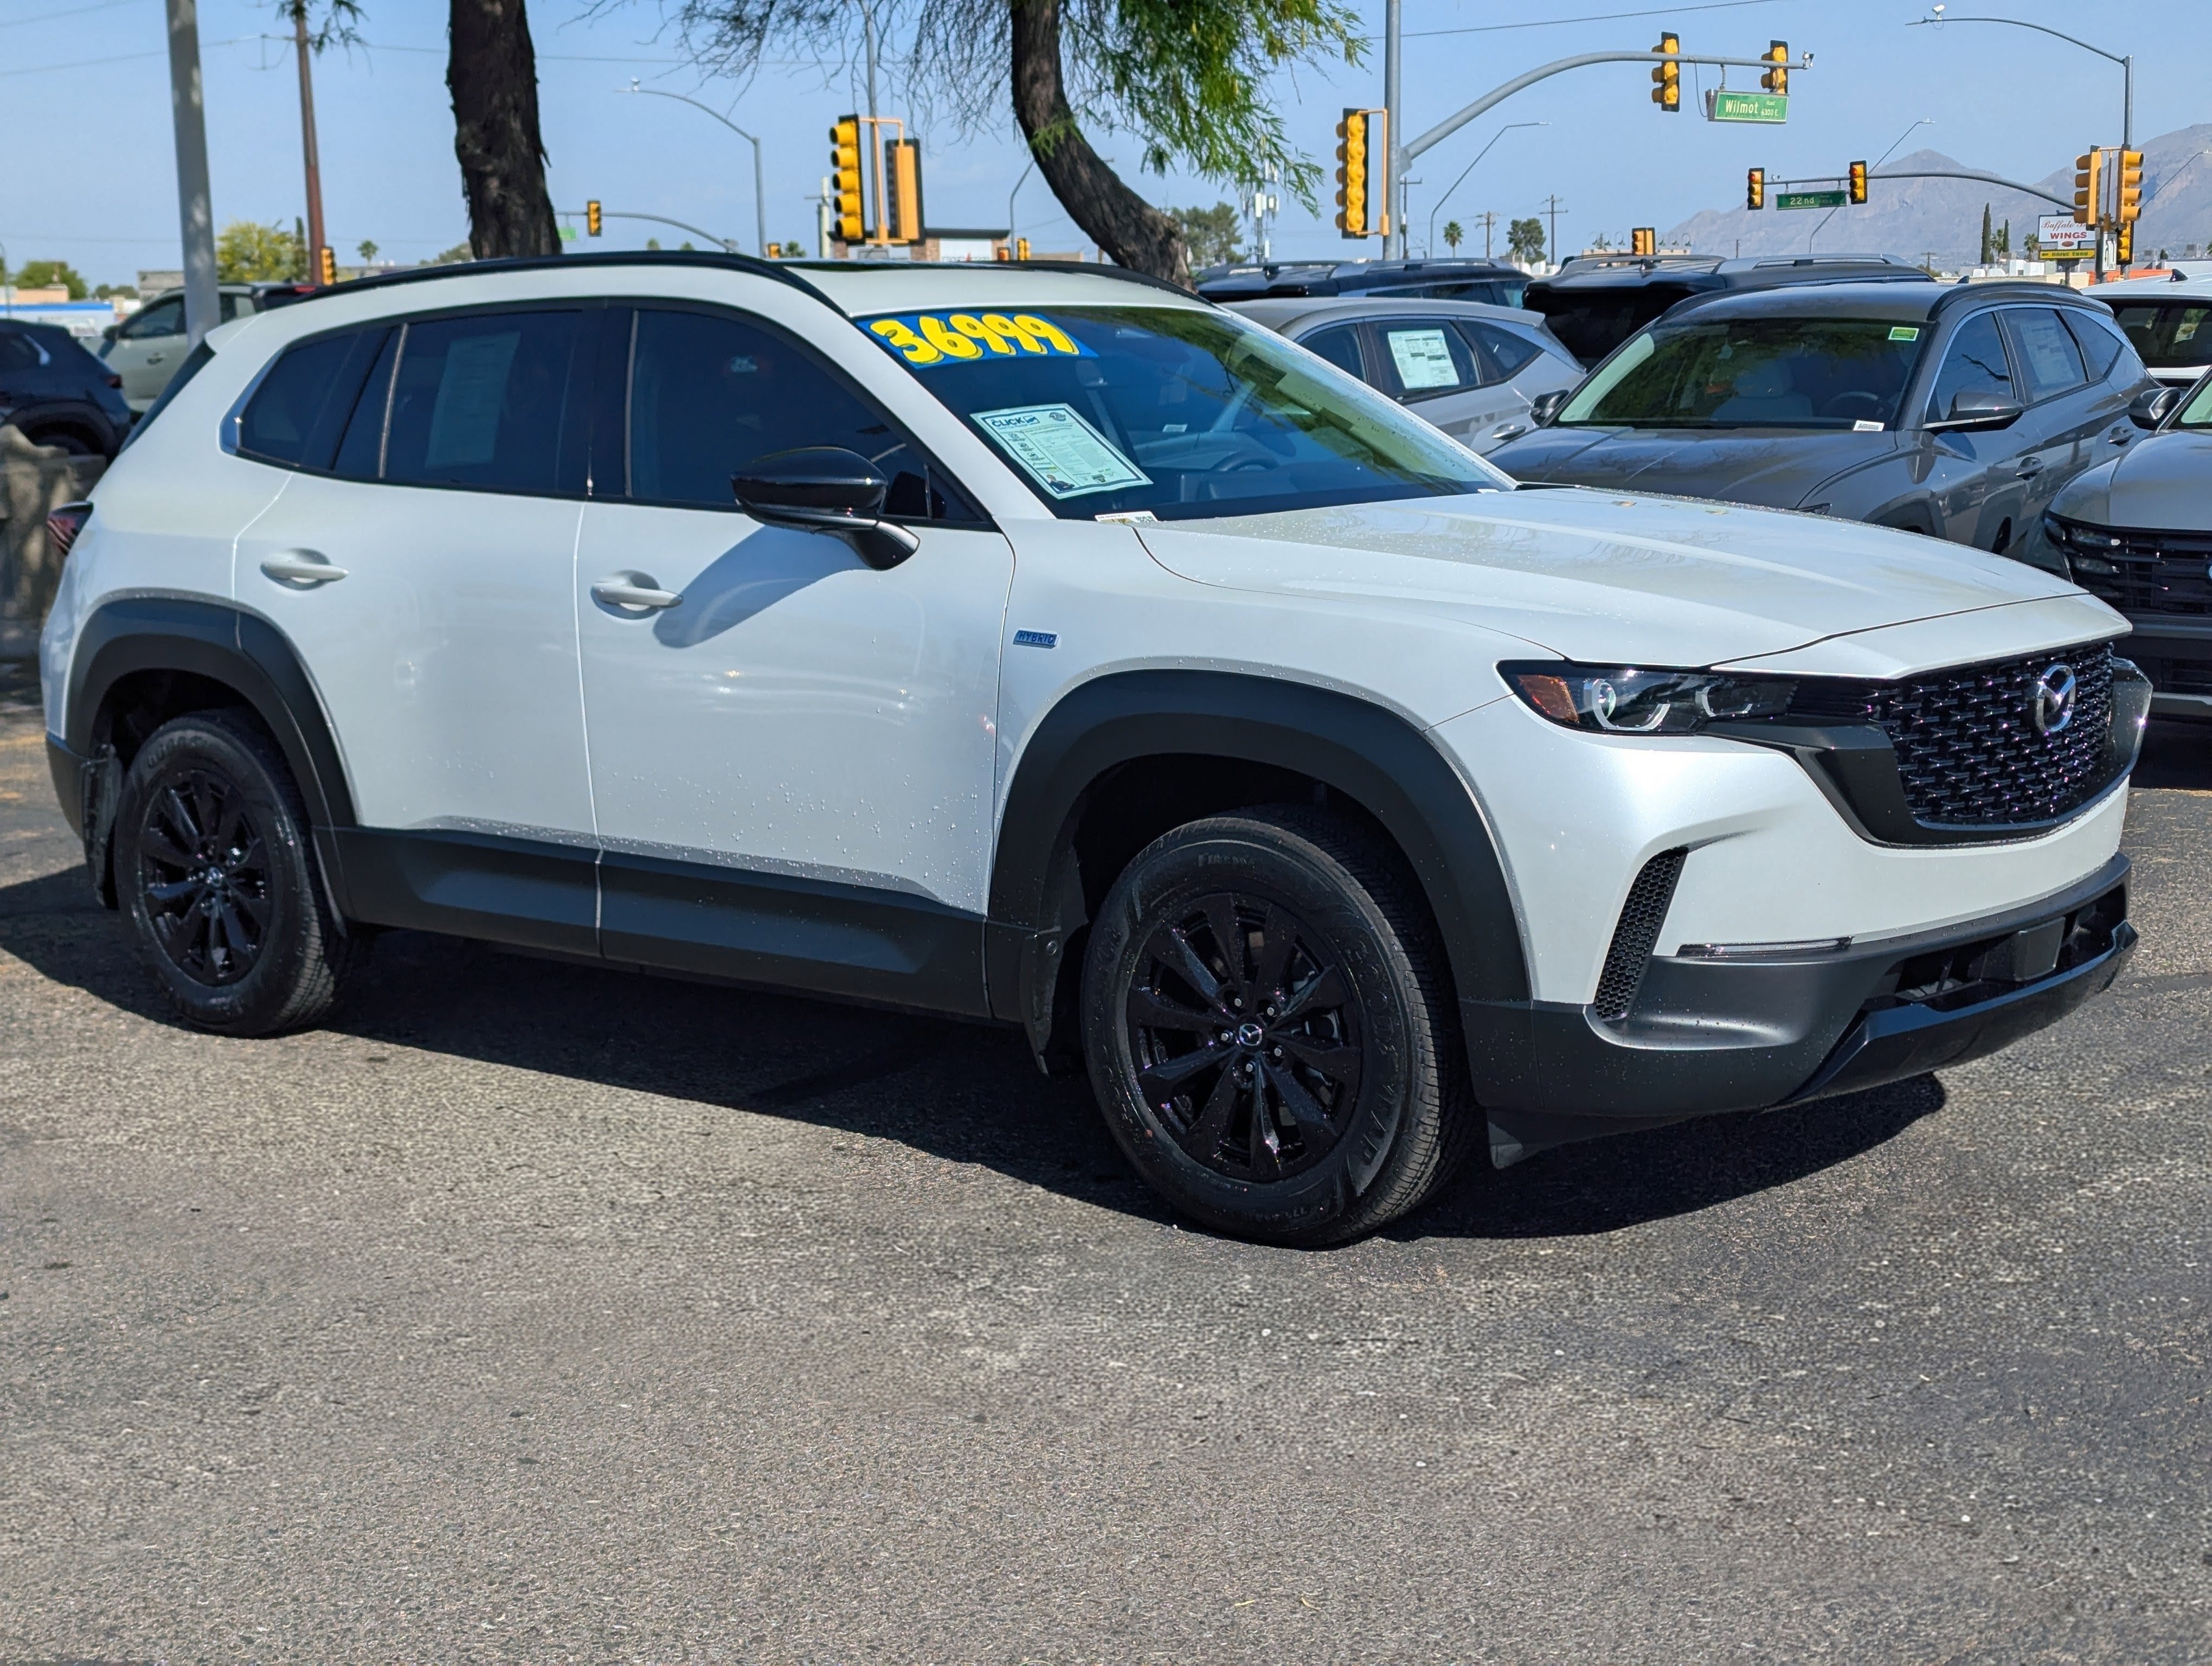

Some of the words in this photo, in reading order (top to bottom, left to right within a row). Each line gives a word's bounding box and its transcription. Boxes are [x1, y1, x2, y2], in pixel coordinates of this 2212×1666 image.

[1726, 100, 1758, 114] Wilmot
[1790, 197, 1814, 205] 22nd
[2041, 220, 2075, 232] Buffalo
[870, 314, 1079, 363] 36999
[992, 417, 1025, 427] CLICK
[1019, 631, 1054, 644] HYBRID
